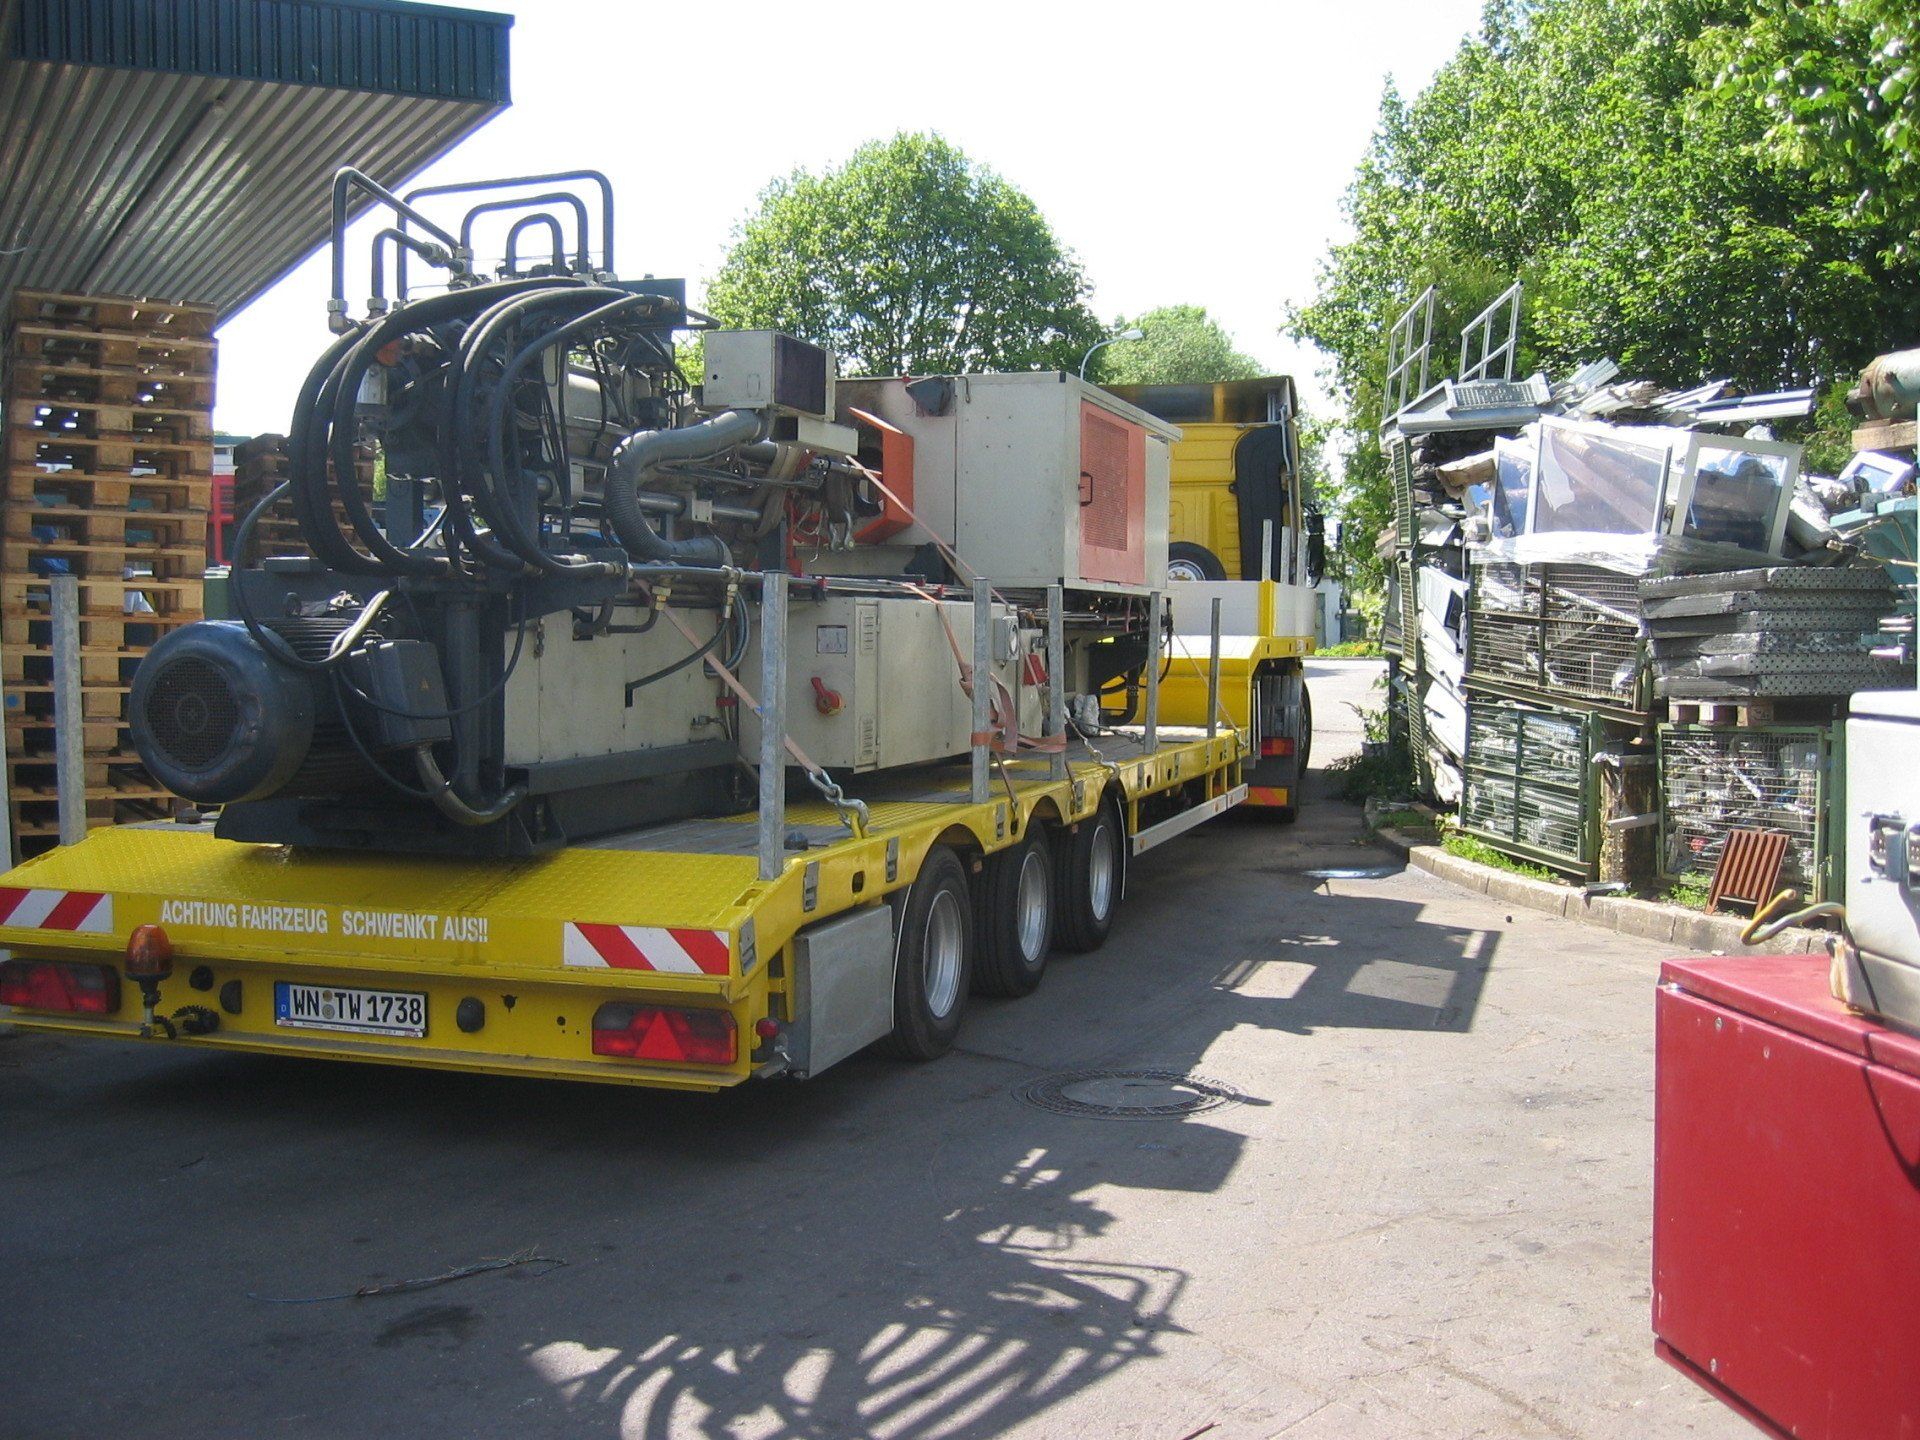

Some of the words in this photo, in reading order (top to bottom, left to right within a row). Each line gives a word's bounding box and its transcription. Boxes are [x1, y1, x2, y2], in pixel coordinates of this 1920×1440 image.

[161, 900, 237, 928] ACHTUNG
[242, 905, 328, 933] FAHRZEUG
[342, 910, 438, 939] SCHWENKT
[443, 916, 488, 942] AUS!!
[293, 989, 320, 1017] WN
[334, 992, 361, 1020] TW
[367, 995, 422, 1025] 1738
